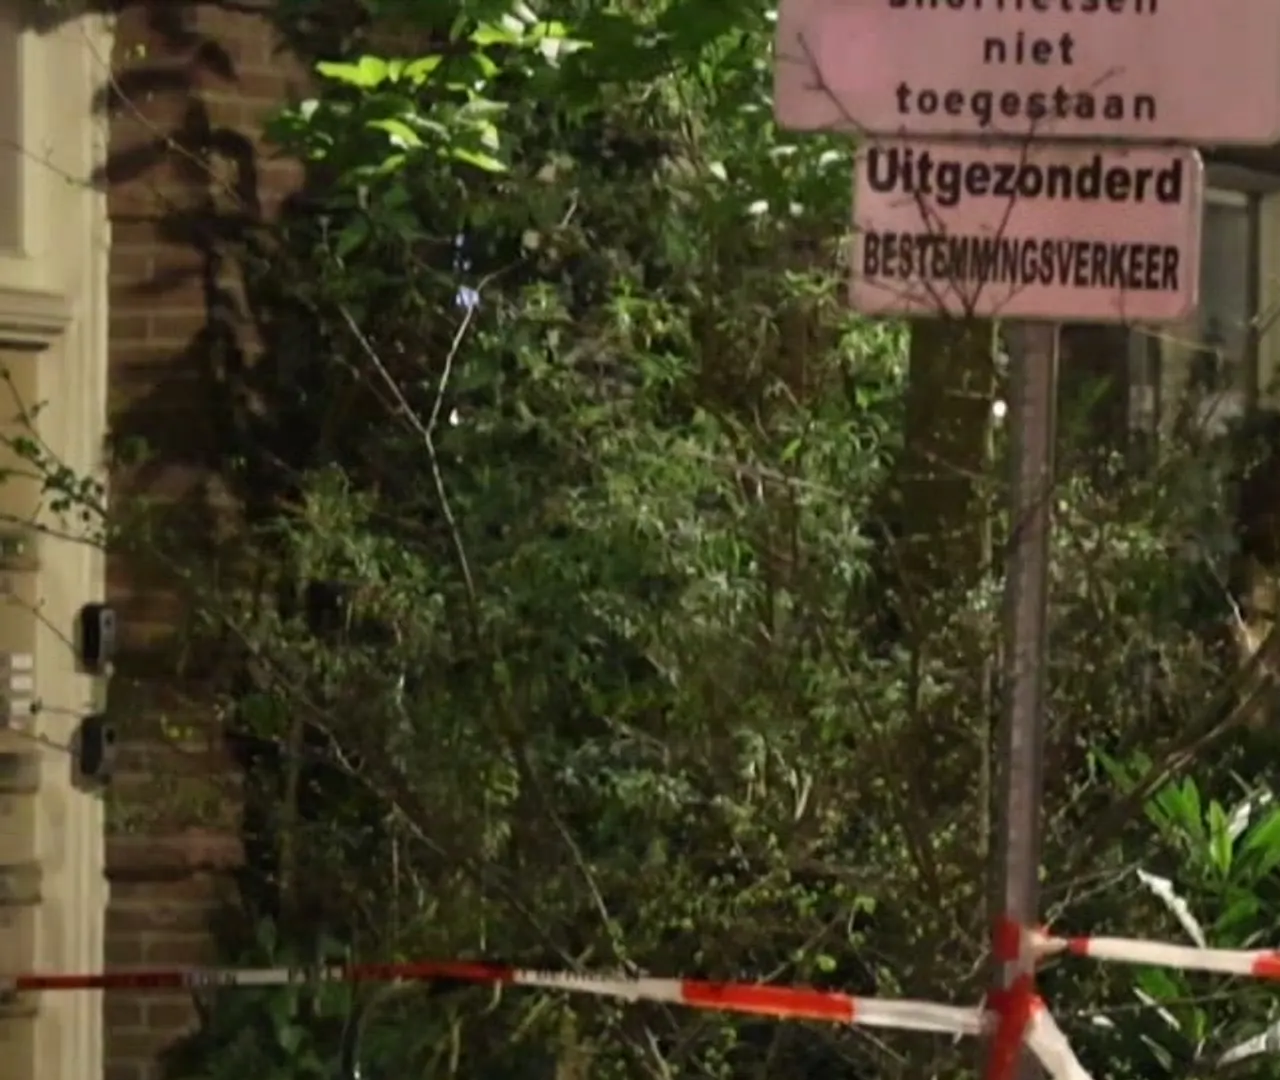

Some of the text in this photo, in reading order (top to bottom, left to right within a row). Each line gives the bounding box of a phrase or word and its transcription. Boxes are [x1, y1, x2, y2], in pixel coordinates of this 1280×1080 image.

[983, 30, 1074, 65] niet
[896, 81, 1156, 128] toegestaan
[867, 148, 1183, 206] Uitgezonderd
[863, 231, 1179, 291] BESTEMMINGSVERKEER
